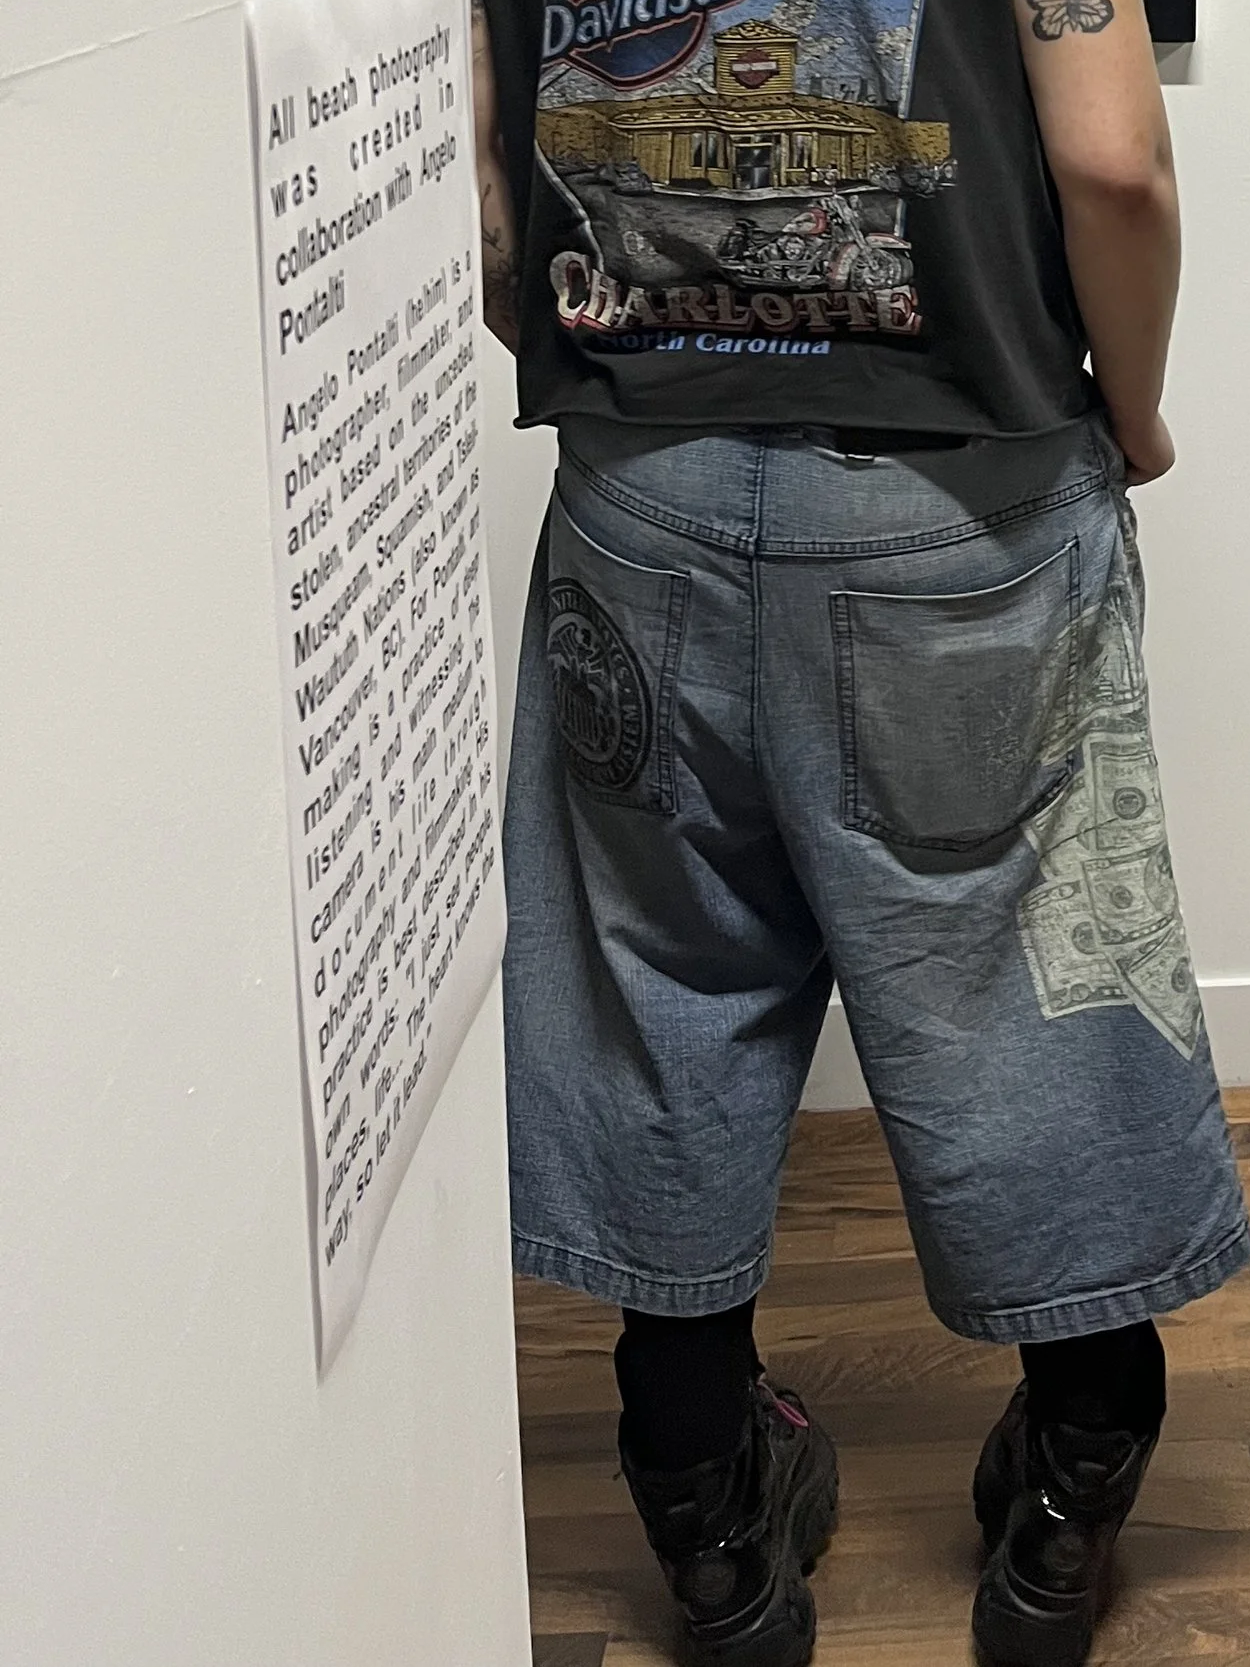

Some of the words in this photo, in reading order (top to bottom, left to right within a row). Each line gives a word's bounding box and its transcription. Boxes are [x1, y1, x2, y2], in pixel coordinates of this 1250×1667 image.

[269, 95, 295, 150] All
[307, 68, 358, 130] beach
[368, 24, 451, 107] photography
[271, 164, 318, 217] was
[350, 94, 422, 172] created
[438, 79, 454, 114] in
[276, 190, 382, 286] collaboration
[385, 161, 413, 212] with
[420, 132, 456, 186] Angelo
[279, 270, 345, 356] Pontalti
[550, 252, 923, 334] CHARLOTTE
[282, 371, 338, 444] Angelo
[348, 317, 398, 387] Pontalti
[451, 258, 461, 288] is
[466, 249, 471, 272] a
[285, 382, 391, 508] photographer,
[397, 321, 453, 391] filmmaker,
[457, 293, 473, 331] and
[287, 486, 333, 556] artist
[340, 434, 381, 503] based
[389, 418, 404, 450] on
[411, 388, 428, 427] the
[435, 336, 474, 400] unceded
[695, 334, 831, 356] Carolina
[290, 541, 343, 611] stolen,
[346, 466, 400, 553] ancestral
[404, 412, 451, 486] territories
[454, 390, 462, 423] of
[465, 380, 477, 412] the
[294, 560, 372, 668] Musqueam,
[377, 484, 433, 569] Squamish,
[437, 450, 454, 496] and
[295, 631, 359, 723] Waututh
[363, 571, 405, 644] Nations
[411, 531, 436, 588] (also
[441, 480, 467, 539] known
[470, 467, 479, 495] as
[298, 664, 378, 777] Vancouver,
[411, 589, 428, 631] For
[469, 505, 479, 541] art
[303, 741, 360, 836] making
[369, 711, 380, 747] is
[388, 690, 394, 715] a
[402, 616, 445, 703] practice
[451, 587, 459, 621] of
[306, 779, 372, 891] listening
[380, 723, 401, 779] and
[409, 633, 464, 733] witnessing.
[310, 851, 364, 944] camera
[371, 819, 381, 852] is
[389, 777, 405, 823] his
[413, 727, 437, 780] main
[475, 637, 484, 665] to
[413, 776, 436, 835] life
[319, 895, 396, 1063] photography
[402, 845, 421, 905] and
[323, 998, 373, 1118] practice
[378, 966, 388, 1002] is
[394, 908, 417, 974] best
[422, 801, 466, 916] described
[324, 1118, 370, 1223] places,
[406, 993, 426, 1050] The
[429, 936, 453, 1004] heart
[455, 879, 480, 948] knows
[326, 1093, 350, 1159] own
[422, 915, 440, 980] just
[446, 874, 460, 918] see
[325, 1201, 353, 1268] way,
[356, 1159, 373, 1202] so
[376, 1115, 391, 1167] let
[394, 1095, 401, 1133] it
